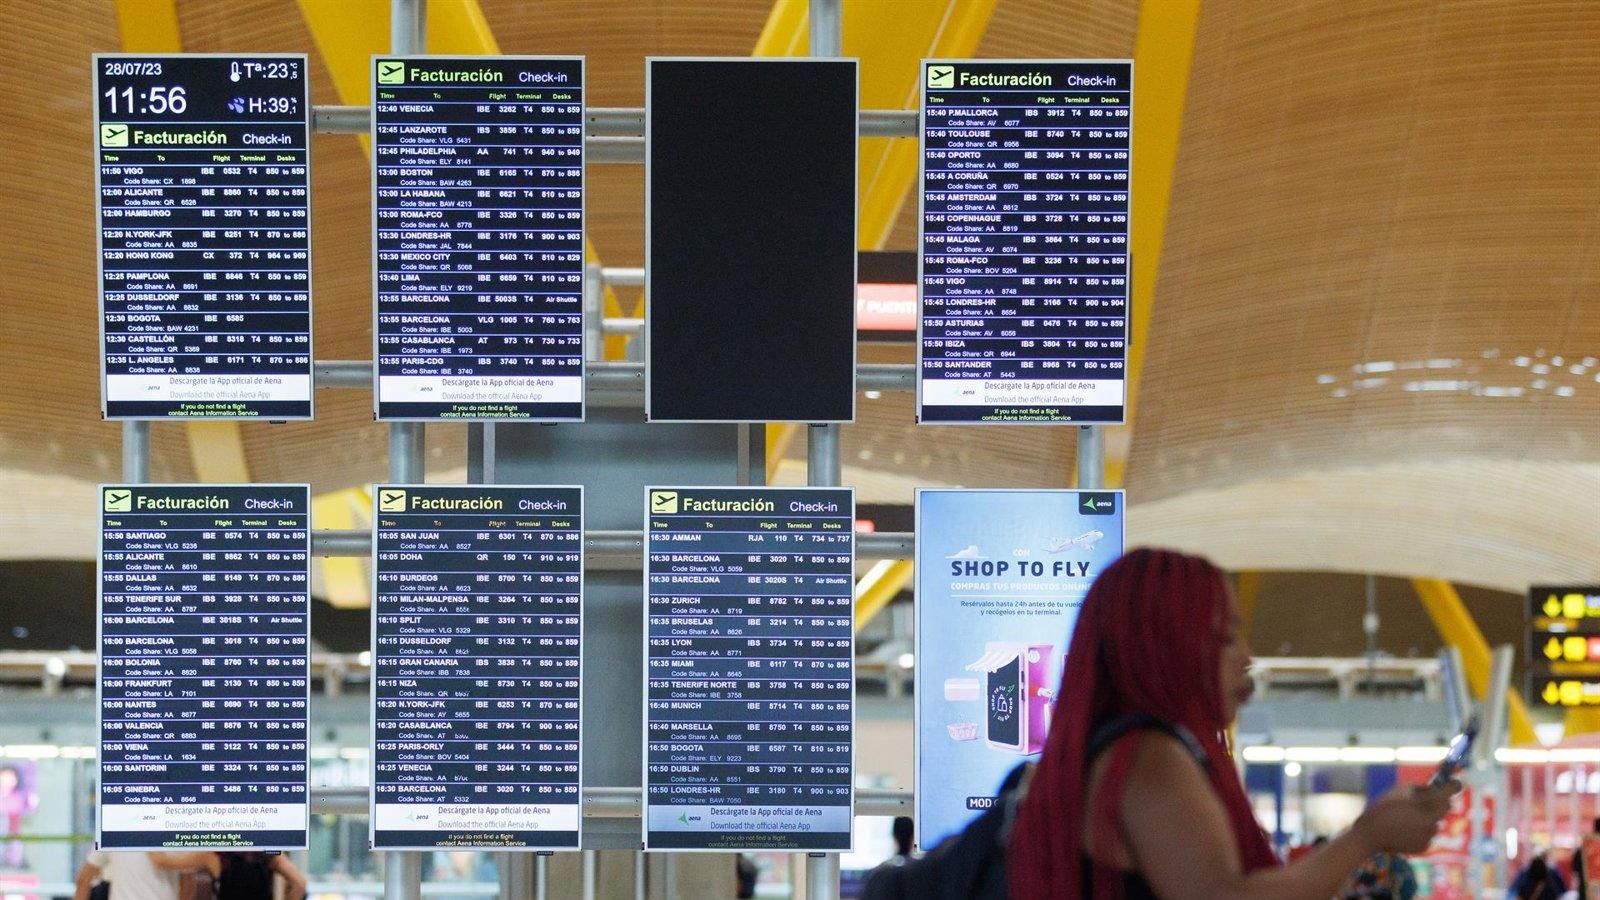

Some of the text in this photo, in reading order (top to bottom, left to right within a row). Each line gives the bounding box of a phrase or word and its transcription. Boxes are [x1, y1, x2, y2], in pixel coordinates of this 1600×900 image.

[105, 63, 162, 75] 28/07/23
[411, 68, 567, 82] Facturación Check-in
[960, 72, 1116, 86] Facturación Check-in
[105, 86, 187, 114] 11:56
[477, 105, 490, 113] IBE
[400, 126, 447, 134] LANZAROTE
[134, 130, 291, 144] Facturación Check-in
[378, 147, 457, 155] 12:45 PHILADELPHIA
[948, 151, 981, 159] OPORTO
[102, 167, 143, 175] 11:50 VIGO
[137, 496, 293, 509] Facturación Check-in
[412, 496, 566, 510] Facturación Check-in
[684, 498, 838, 512] Facturación Check-in
[748, 534, 764, 542] RJA
[951, 560, 1090, 577] SHOP TO FLY
[104, 574, 124, 582] 15:55
[951, 582, 990, 590] COMPRAS
[992, 582, 1009, 590] TUS
[399, 616, 422, 624] SPLIT
[125, 764, 167, 772] SANTORINI
[710, 807, 822, 817] Descárgate la App oficial de Aena
[710, 821, 811, 831] Download the official Aena App
